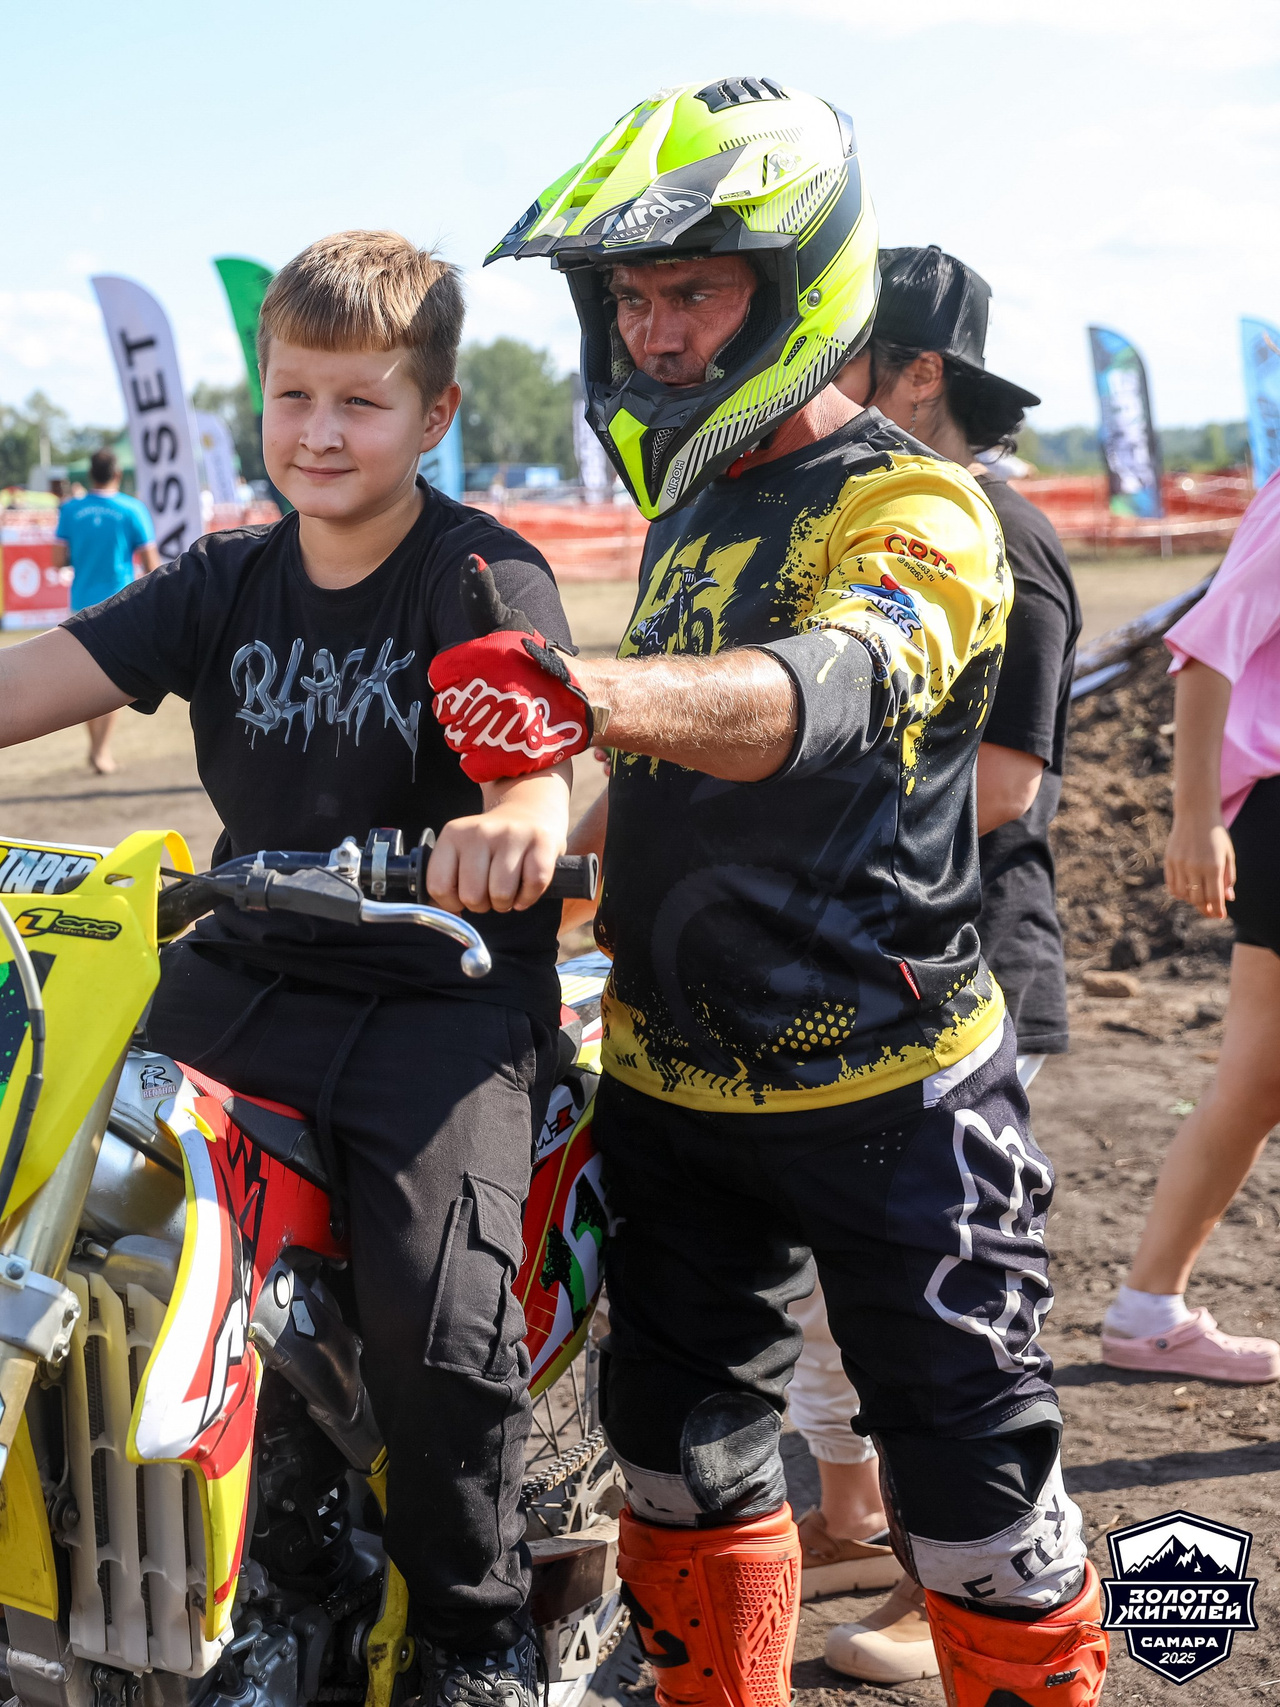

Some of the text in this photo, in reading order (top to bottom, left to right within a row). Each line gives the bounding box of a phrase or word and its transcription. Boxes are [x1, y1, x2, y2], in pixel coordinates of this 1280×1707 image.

[119, 327, 188, 562] ASSET
[666, 459, 686, 499] AIROH
[143, 1084, 178, 1099] RENTHAL
